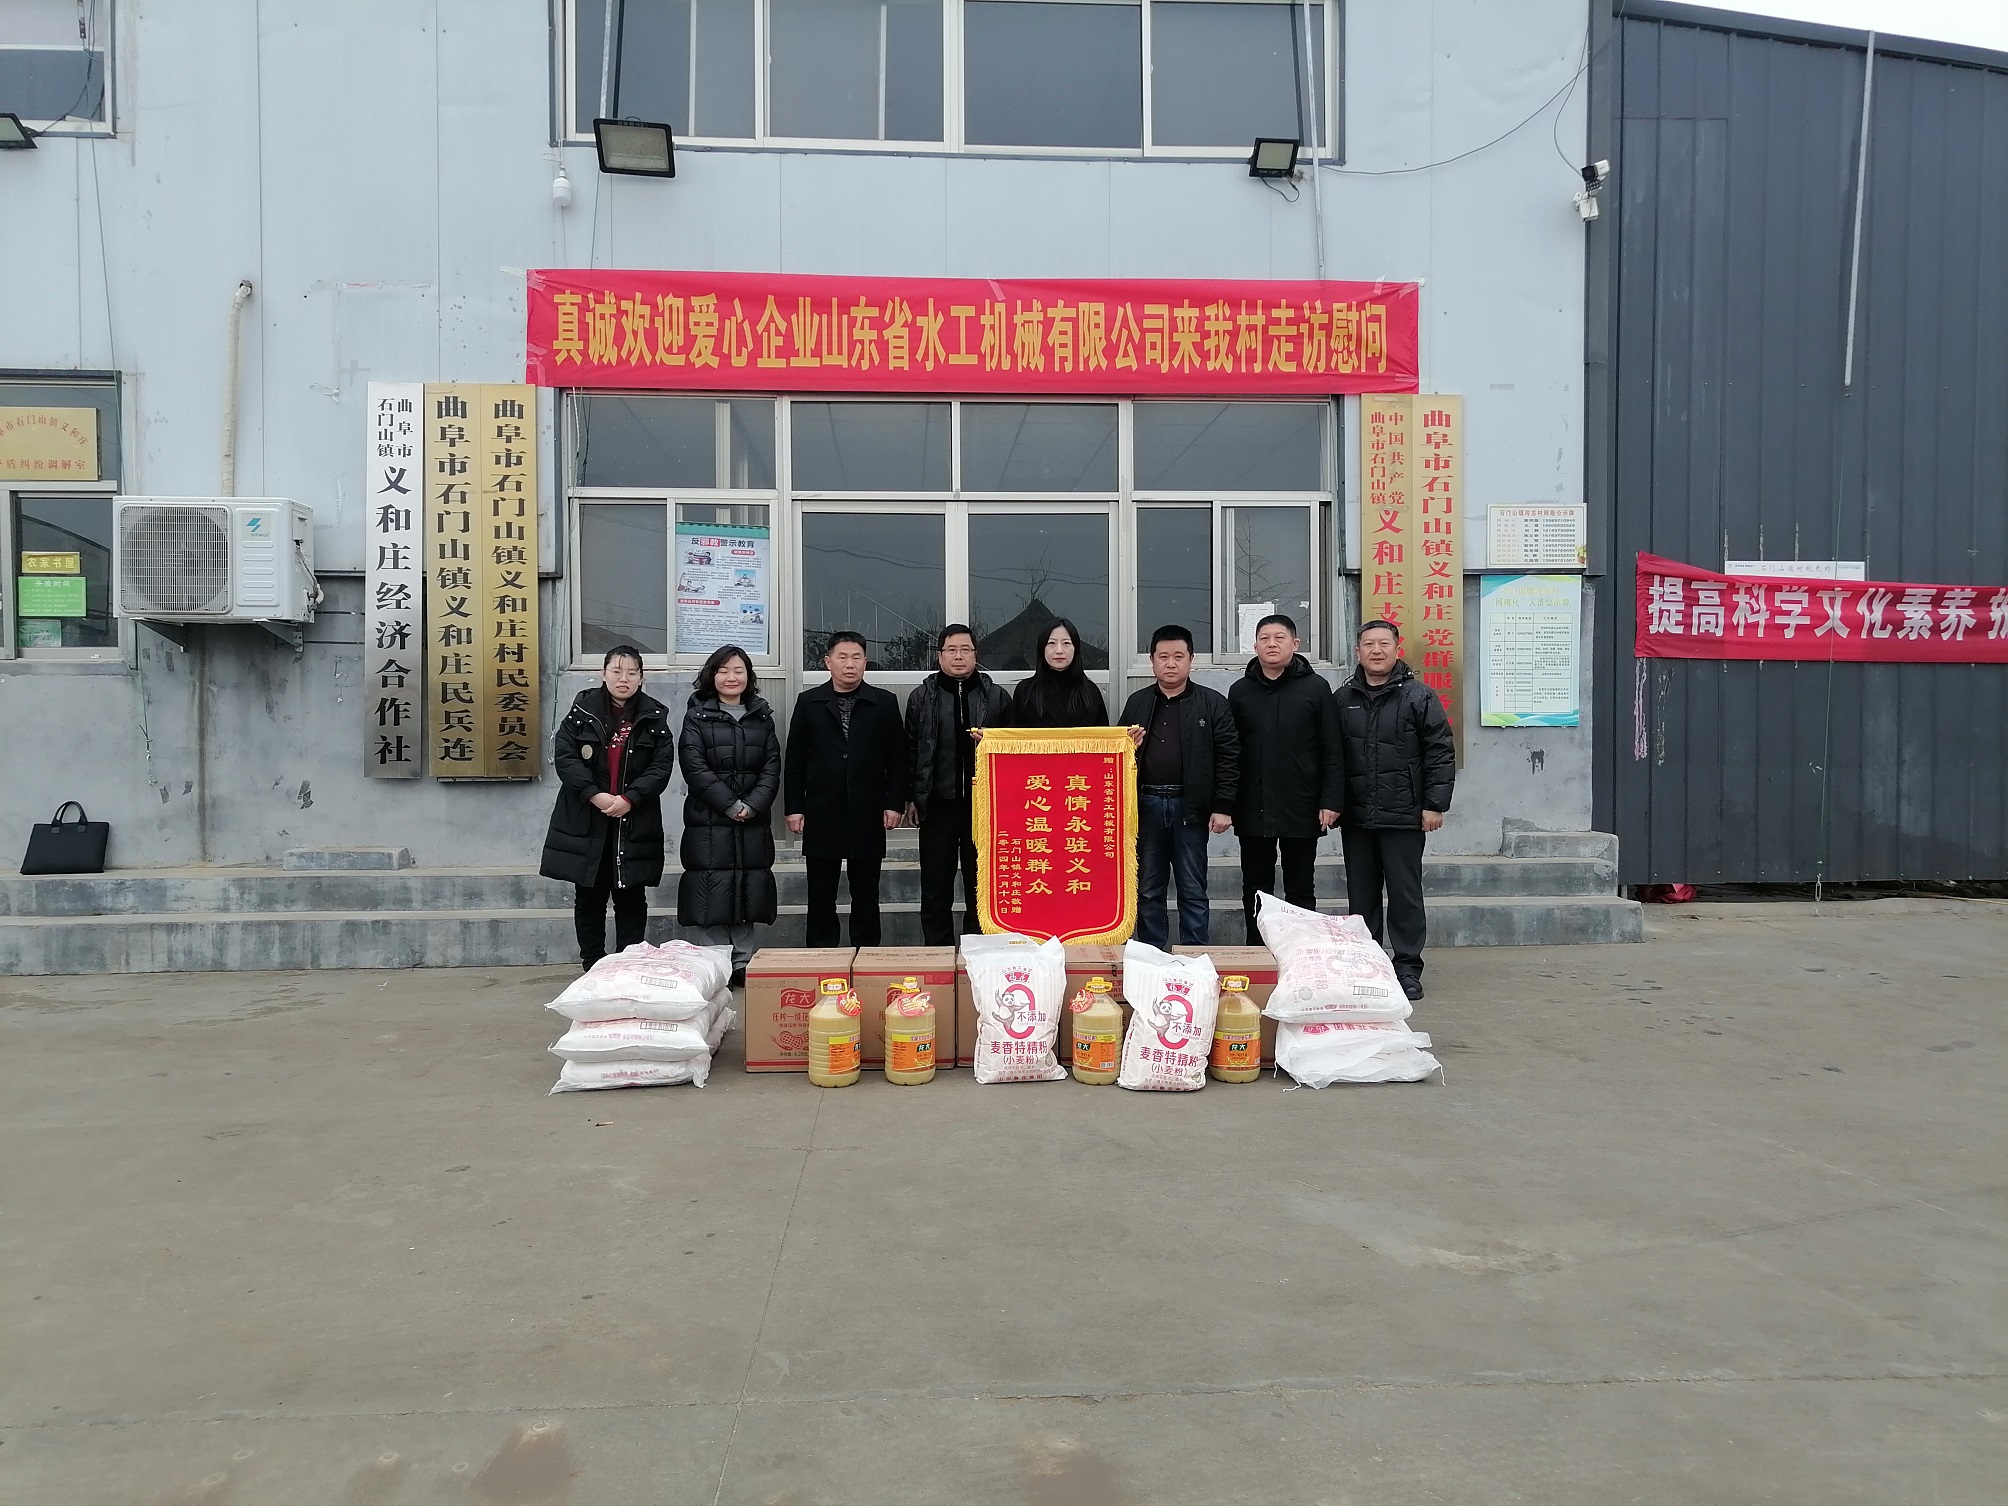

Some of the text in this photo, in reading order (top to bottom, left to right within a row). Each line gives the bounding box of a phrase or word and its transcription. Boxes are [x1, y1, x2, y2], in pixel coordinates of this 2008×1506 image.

[552, 290, 1387, 374] 真诚欢迎爱心企业山东省水工机械有限公司来我村走访慰问
[0, 458, 86, 470] 盾纠纷调解室
[1370, 411, 1387, 505] 曲阜市石门山镇
[1388, 412, 1405, 505] 中国共产党
[26, 557, 75, 569] 农家书屋
[374, 397, 413, 765] 曲阜市 石门山镇 义和庄经济合作社
[434, 395, 475, 762] 曲阜市石门山镇义和庄民兵连
[490, 399, 531, 761] 曲阜市石门山镇义和庄村民委员会
[1420, 410, 1455, 727] 曲阜市石门山镇义和庄党群服
[1024, 774, 1053, 896] 爱心温暖群众
[1064, 774, 1092, 895] 真情永驻义和
[785, 993, 811, 1004] 龙大
[1016, 1011, 1047, 1022] 不添加
[1171, 1021, 1202, 1037] 不添加
[990, 1041, 1048, 1054] 麦香特精粉
[1139, 1046, 1198, 1068] 麦香特精粉
